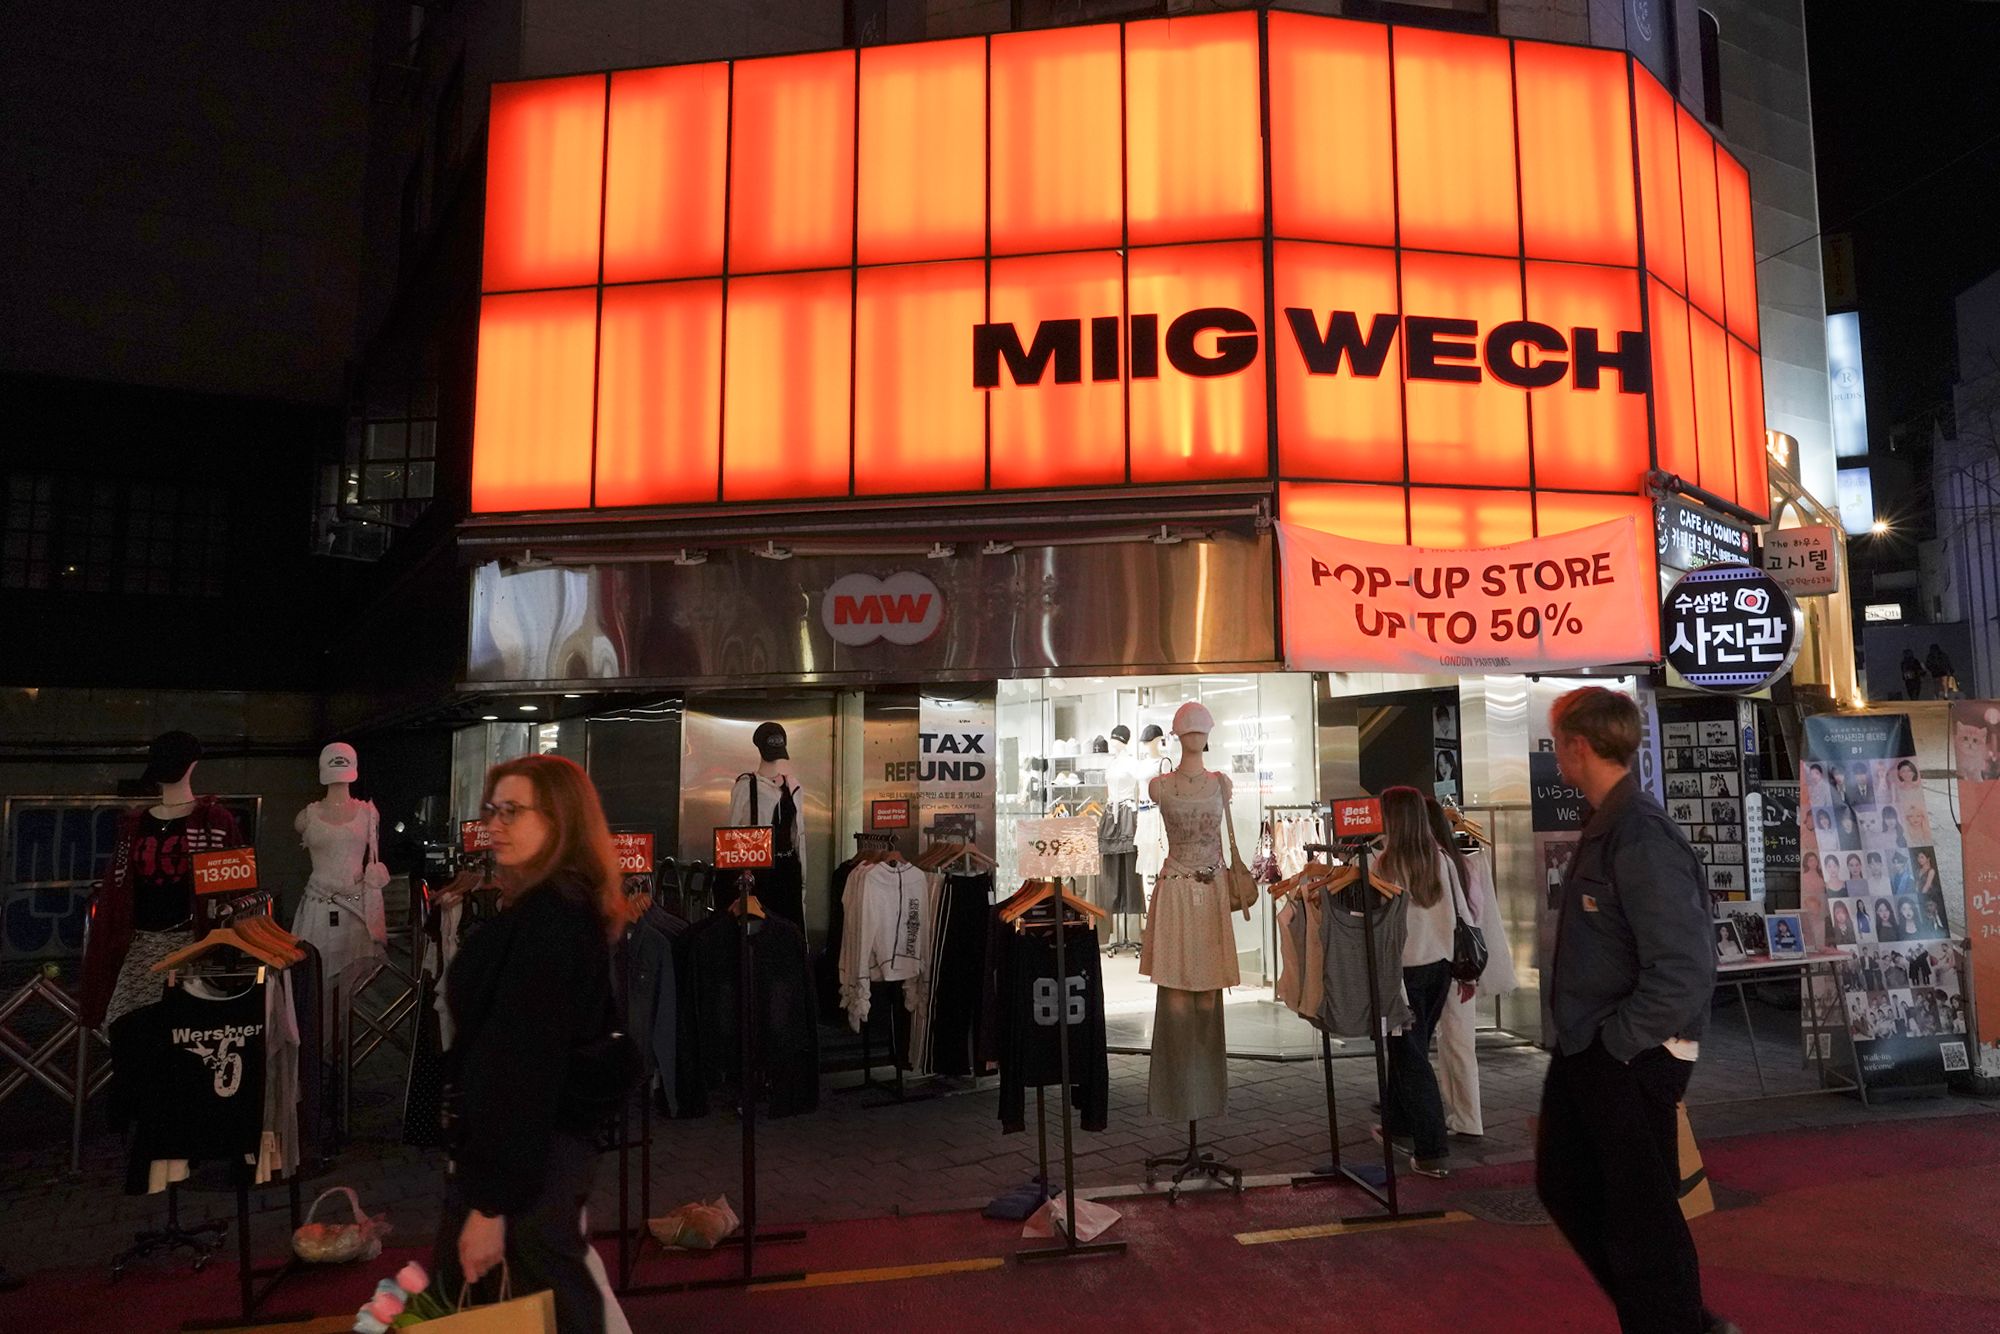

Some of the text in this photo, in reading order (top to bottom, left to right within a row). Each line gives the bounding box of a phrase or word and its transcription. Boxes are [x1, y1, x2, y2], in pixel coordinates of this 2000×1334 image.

[1680, 509, 1702, 531] CAFE
[1713, 523, 1741, 547] COMICS
[1671, 527, 1719, 561] 카페데코믹스
[1766, 549, 1827, 571] 고시텔
[1311, 552, 1615, 598] POP-UP STORE
[834, 594, 932, 624] MW
[1675, 591, 1728, 615] 수상한
[1355, 602, 1583, 645] UP TO 50%
[1669, 617, 1788, 666] 사진관
[1440, 655, 1472, 667] LONDON
[918, 733, 985, 754] TAX
[885, 761, 986, 781] REFUND
[1344, 816, 1372, 826] Price
[1345, 806, 1369, 816] Best
[1033, 976, 1086, 1025] 86
